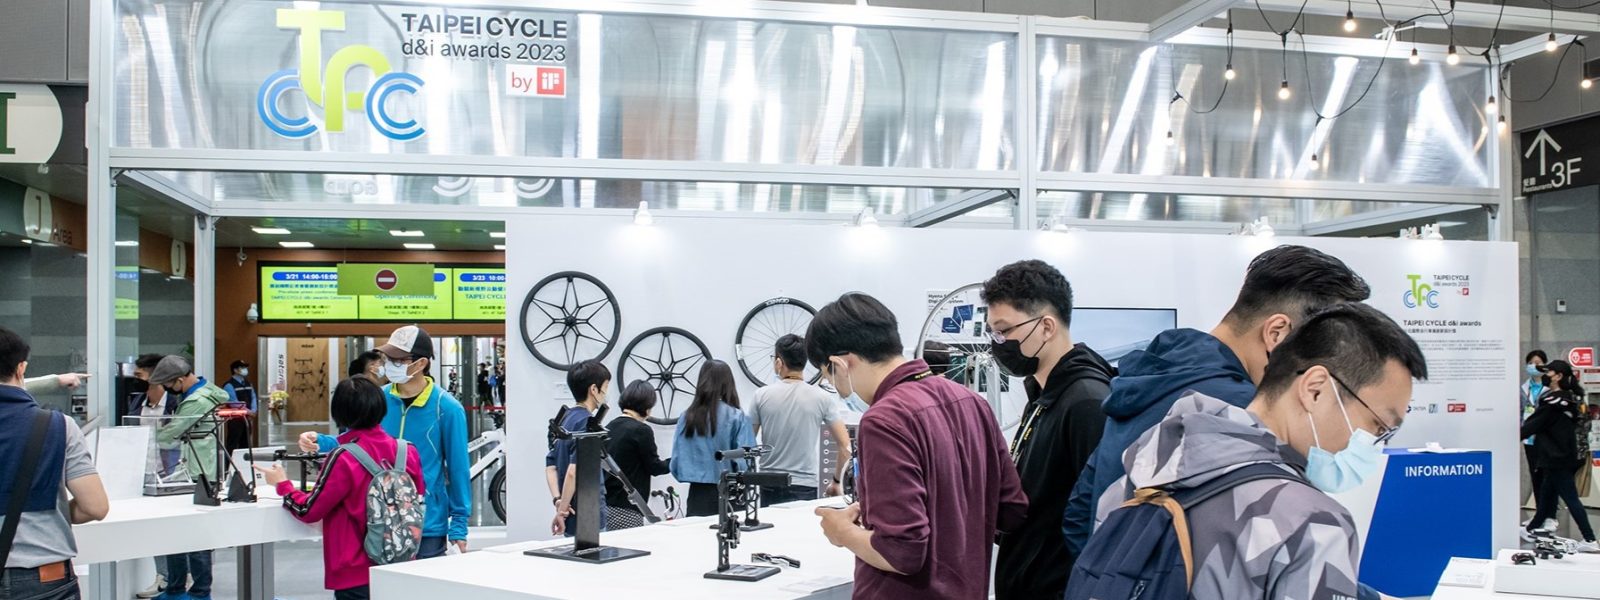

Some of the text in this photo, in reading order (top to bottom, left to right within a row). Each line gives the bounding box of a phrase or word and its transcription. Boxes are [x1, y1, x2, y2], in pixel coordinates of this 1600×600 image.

[401, 12, 568, 38] TAIPEI CYCLE
[401, 38, 567, 61] d&i awards 2023
[511, 72, 533, 92] by
[1550, 157, 1582, 188] 3F
[53, 228, 73, 244] Area
[1403, 319, 1424, 327] TAIPEI
[1425, 319, 1446, 327] CYCLE
[1405, 464, 1483, 477] INFORMATION
